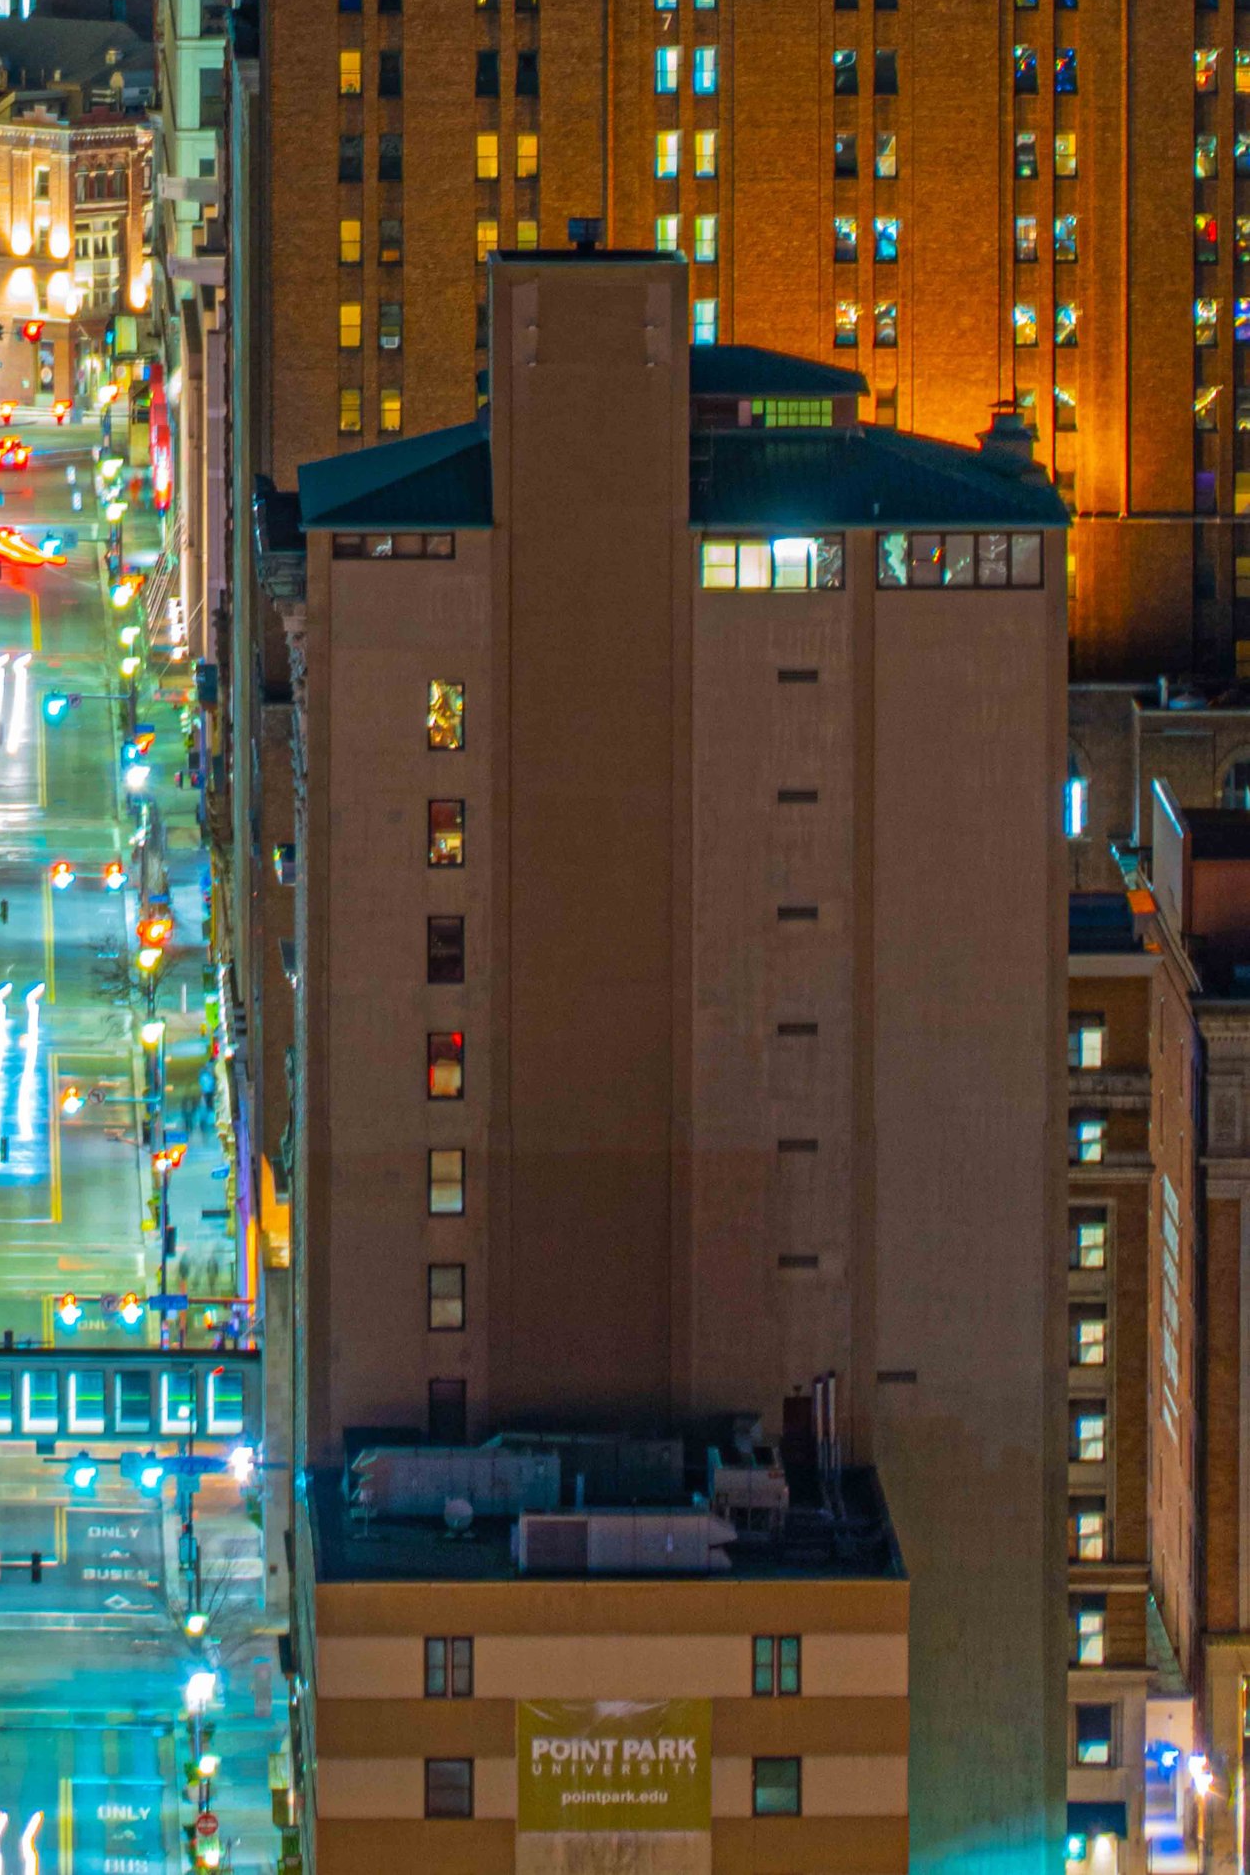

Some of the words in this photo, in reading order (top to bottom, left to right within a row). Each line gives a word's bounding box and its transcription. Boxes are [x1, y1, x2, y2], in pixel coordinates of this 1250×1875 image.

[88, 1526, 140, 1538] ONLY
[532, 1738, 618, 1761] POINT
[623, 1738, 697, 1761] PARK
[532, 1763, 697, 1776] UNIVERSITY
[562, 1789, 668, 1805] pointpark.edu
[97, 1805, 151, 1820] ONLY
